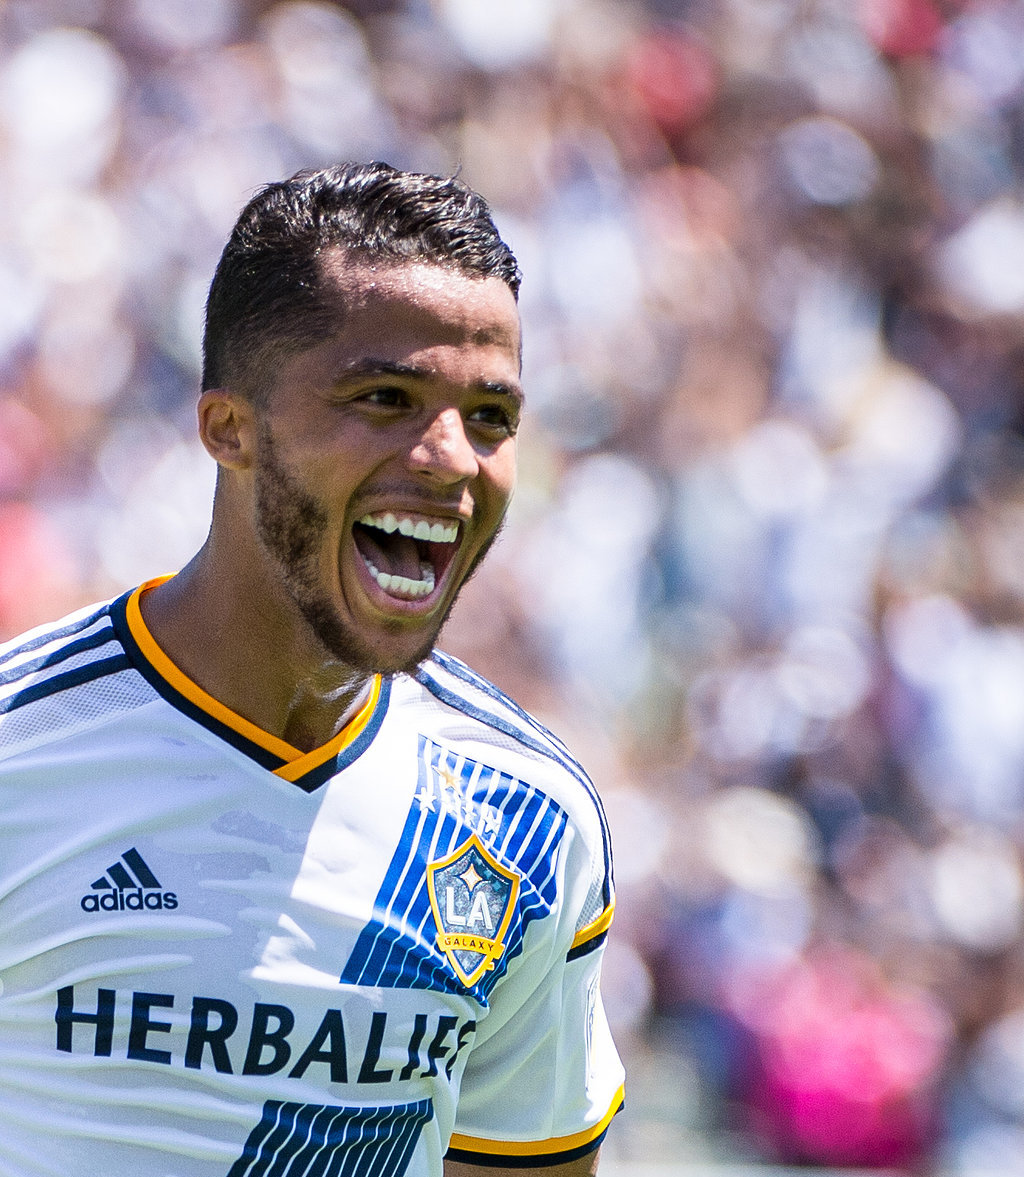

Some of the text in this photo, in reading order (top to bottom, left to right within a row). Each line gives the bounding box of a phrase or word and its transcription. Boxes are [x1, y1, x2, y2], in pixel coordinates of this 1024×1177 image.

[80, 887, 179, 912] adidas
[446, 886, 493, 929] LA
[444, 937, 494, 951] GALAXY
